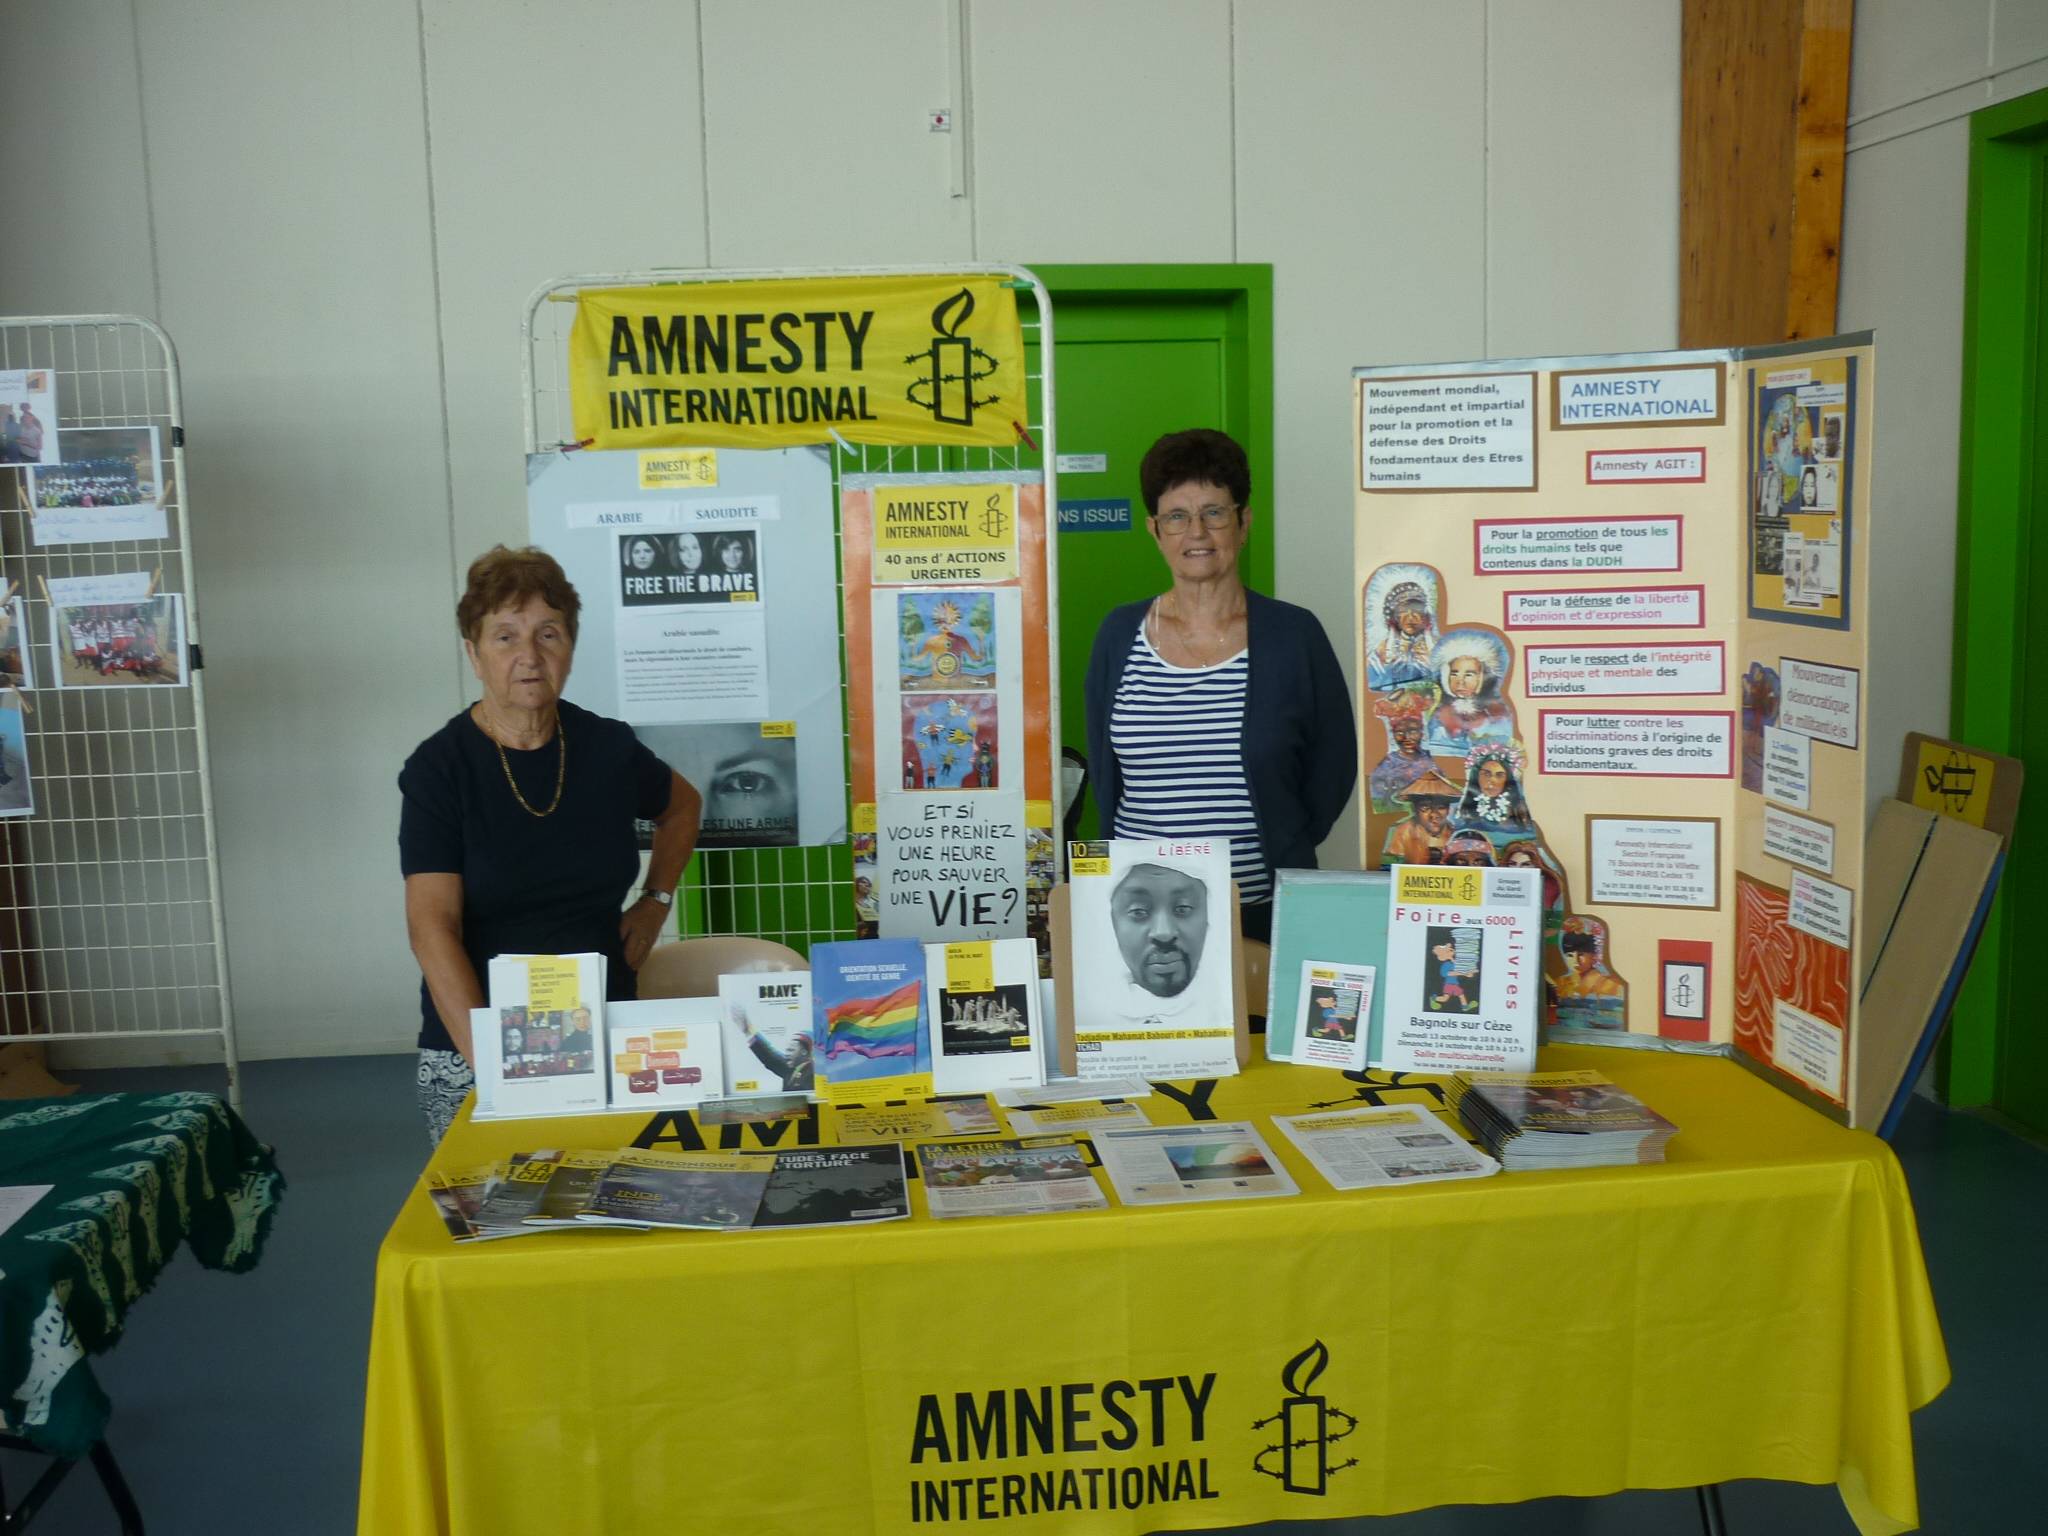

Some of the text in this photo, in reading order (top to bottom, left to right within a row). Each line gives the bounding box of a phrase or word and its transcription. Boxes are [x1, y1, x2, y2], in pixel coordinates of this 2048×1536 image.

[608, 311, 874, 376] AMNESTY
[1369, 384, 1500, 398] Mouvement mondial,
[1571, 379, 1661, 397] AMNESTY
[608, 386, 877, 429] INTERNATIONAL
[1369, 400, 1525, 416] indépendant et impartial
[1563, 399, 1714, 419] INTERNATIONAL
[1369, 417, 1513, 433] pour la promotion et la
[1369, 435, 1487, 448] défense des Droits
[646, 459, 690, 472] AMNESTY
[1369, 454, 1458, 465] fondamentaux
[1462, 453, 1485, 463] des
[1594, 459, 1687, 472] Amnesty AGIT
[645, 472, 691, 482] INTERNATIONAL
[1369, 471, 1421, 481] humains
[597, 507, 758, 524] ARABIE SAOUDITE
[886, 501, 969, 522] AMNESTY
[1058, 508, 1129, 523] NS ISSUE
[885, 524, 970, 539] INTERNATIONAL
[1491, 526, 1669, 541] Pour la promotion de tous les
[1482, 542, 1623, 555] droits humains tels que
[885, 553, 901, 565] 40
[905, 554, 928, 565] ans
[946, 551, 1006, 563] ACTIONS
[1482, 556, 1623, 569] contenus dans la DUDH
[911, 568, 981, 580] URGENTES
[625, 573, 754, 595] FREE THE BRAVE
[1520, 593, 1689, 608] Pour la défense de la liberté
[1511, 609, 1662, 623] d'opinion et d'expression
[1539, 651, 1712, 666] Pour le respect de l'intégrité
[1531, 667, 1678, 681] physique et mentale des
[1792, 664, 1847, 688] Mouvement
[1531, 683, 1585, 693] individus
[1787, 687, 1850, 715] démocratique
[1556, 717, 1684, 729] Pour lutter contre les
[1547, 731, 1722, 744] discriminations à l'origine de
[1547, 745, 1712, 758] violations graves des droits
[1547, 759, 1638, 770] fondamentaux.
[924, 804, 952, 820] ET
[703, 816, 791, 831] EST UNE ARME
[887, 826, 934, 841] VOUS
[899, 845, 997, 862] UNE HEURE
[1072, 843, 1088, 857] 10
[892, 867, 1010, 884] POUR SAUVER
[1404, 875, 1454, 889] AMNESTY
[890, 891, 923, 906] UNE
[1403, 890, 1454, 900] INTERNATIONAL
[1395, 907, 1462, 924] Foire
[1485, 915, 1516, 926] 6000
[1505, 930, 1524, 1010] Livres
[1410, 1017, 1513, 1031] Bagnols sur Cèze
[1397, 1040, 1433, 1048] Dimanche
[1440, 1033, 1467, 1041] octobre
[1414, 1050, 1505, 1062] Salle multiculturelle
[779, 1152, 870, 1164] TUDES FACE
[784, 1159, 854, 1169] TORTURE
[910, 1372, 1217, 1464] AMNESTY
[911, 1458, 1219, 1523] INTERNATIONAL
